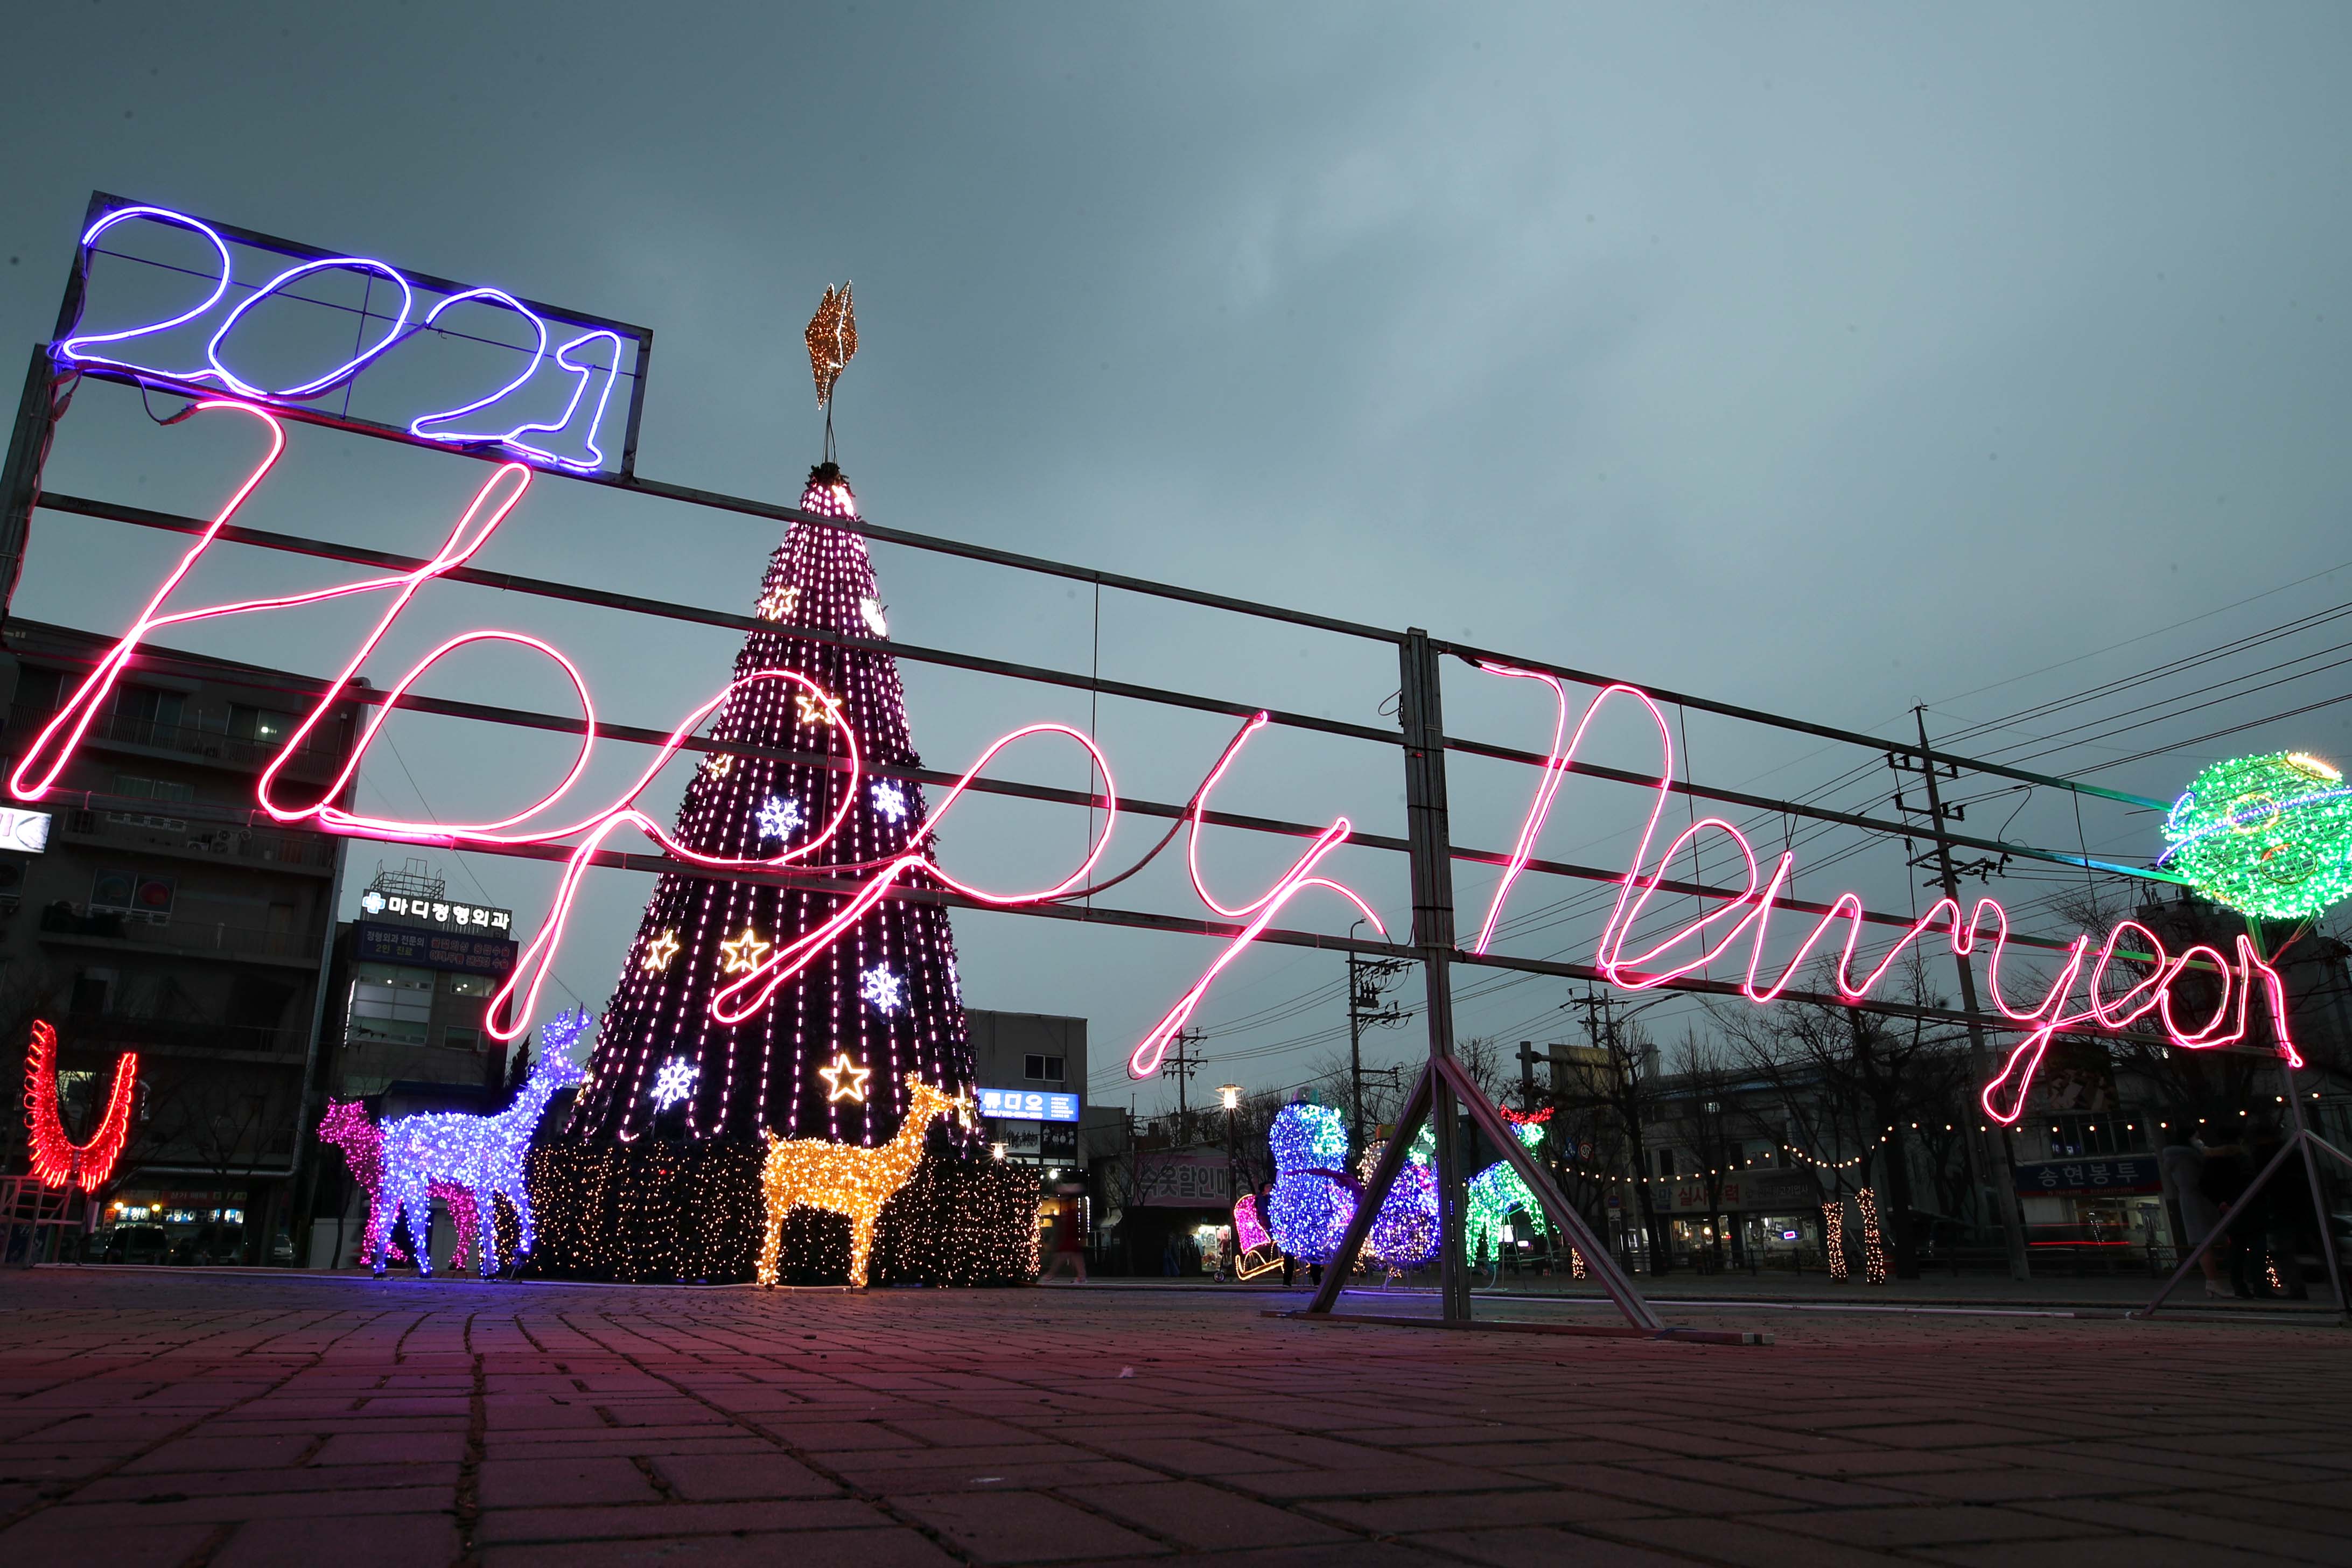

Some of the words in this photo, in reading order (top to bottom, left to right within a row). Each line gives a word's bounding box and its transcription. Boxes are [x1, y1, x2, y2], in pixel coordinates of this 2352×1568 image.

[61, 205, 622, 473] 2021
[9, 397, 1387, 1077] Happy
[388, 895, 510, 930] 마디정형외과
[367, 930, 399, 943] 정형외과
[401, 934, 425, 948] 전문의
[375, 944, 390, 954] 2인
[396, 946, 414, 956] 진료
[2038, 1162, 2140, 1187] 송현봉투
